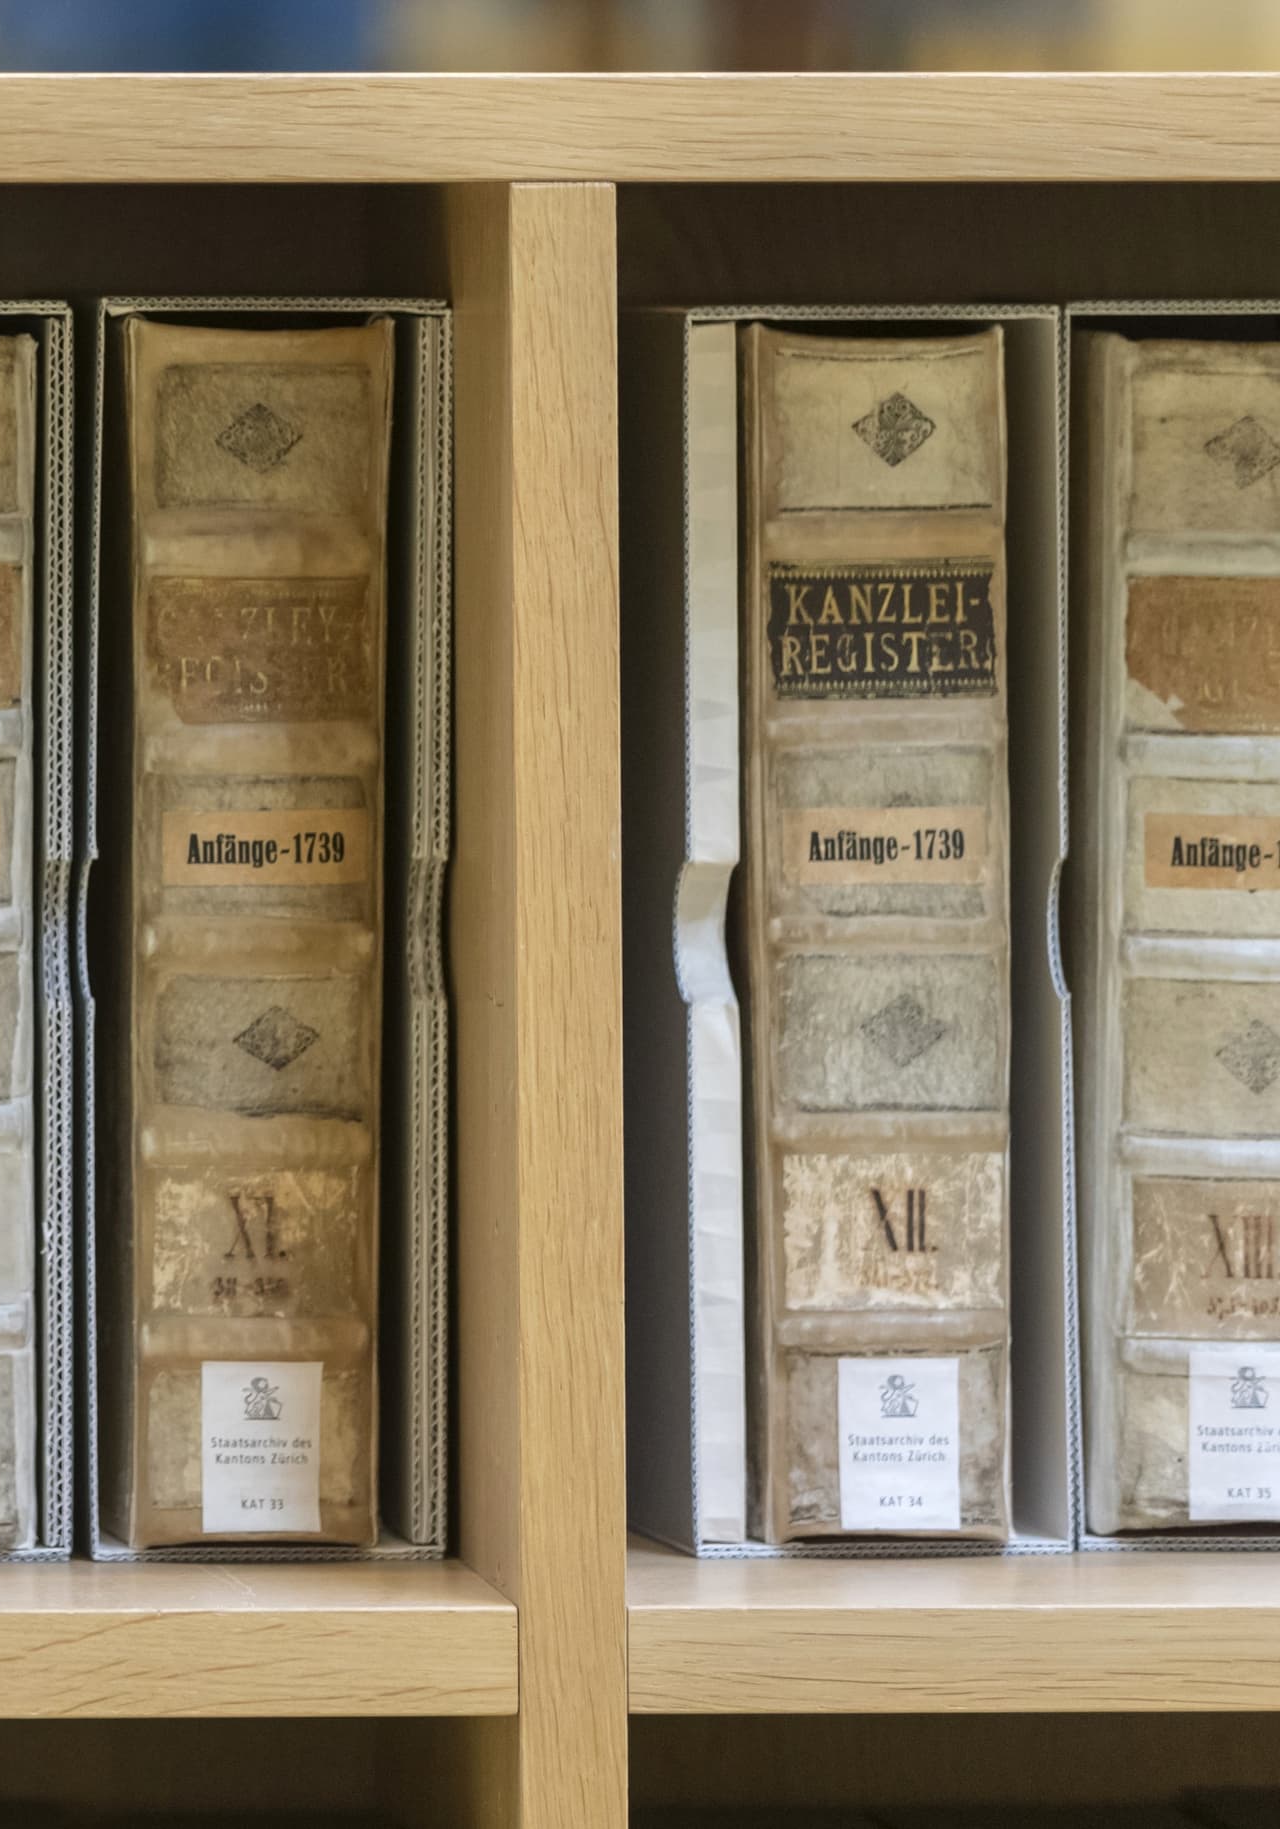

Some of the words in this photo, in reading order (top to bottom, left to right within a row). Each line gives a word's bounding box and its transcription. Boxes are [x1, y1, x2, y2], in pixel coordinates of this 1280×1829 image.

[785, 581, 980, 626] KANZLEI-
[188, 832, 344, 868] Anfänge-1739
[809, 830, 965, 866] Anfänge-1739
[211, 1436, 287, 1449] Staatsarchiv
[291, 1436, 312, 1449] des
[848, 1434, 925, 1447] Staatsarchiv
[929, 1434, 950, 1447] des
[215, 1452, 266, 1465] Kantons
[271, 1452, 308, 1465] Zürich
[853, 1450, 903, 1463] Kantons
[907, 1450, 946, 1463] Zürich
[1227, 1487, 1251, 1500] KAT
[1257, 1487, 1272, 1500] 35
[241, 1497, 265, 1510] KAT
[269, 1497, 284, 1510] 33
[879, 1495, 904, 1508] KAT
[909, 1495, 923, 1508] 34
